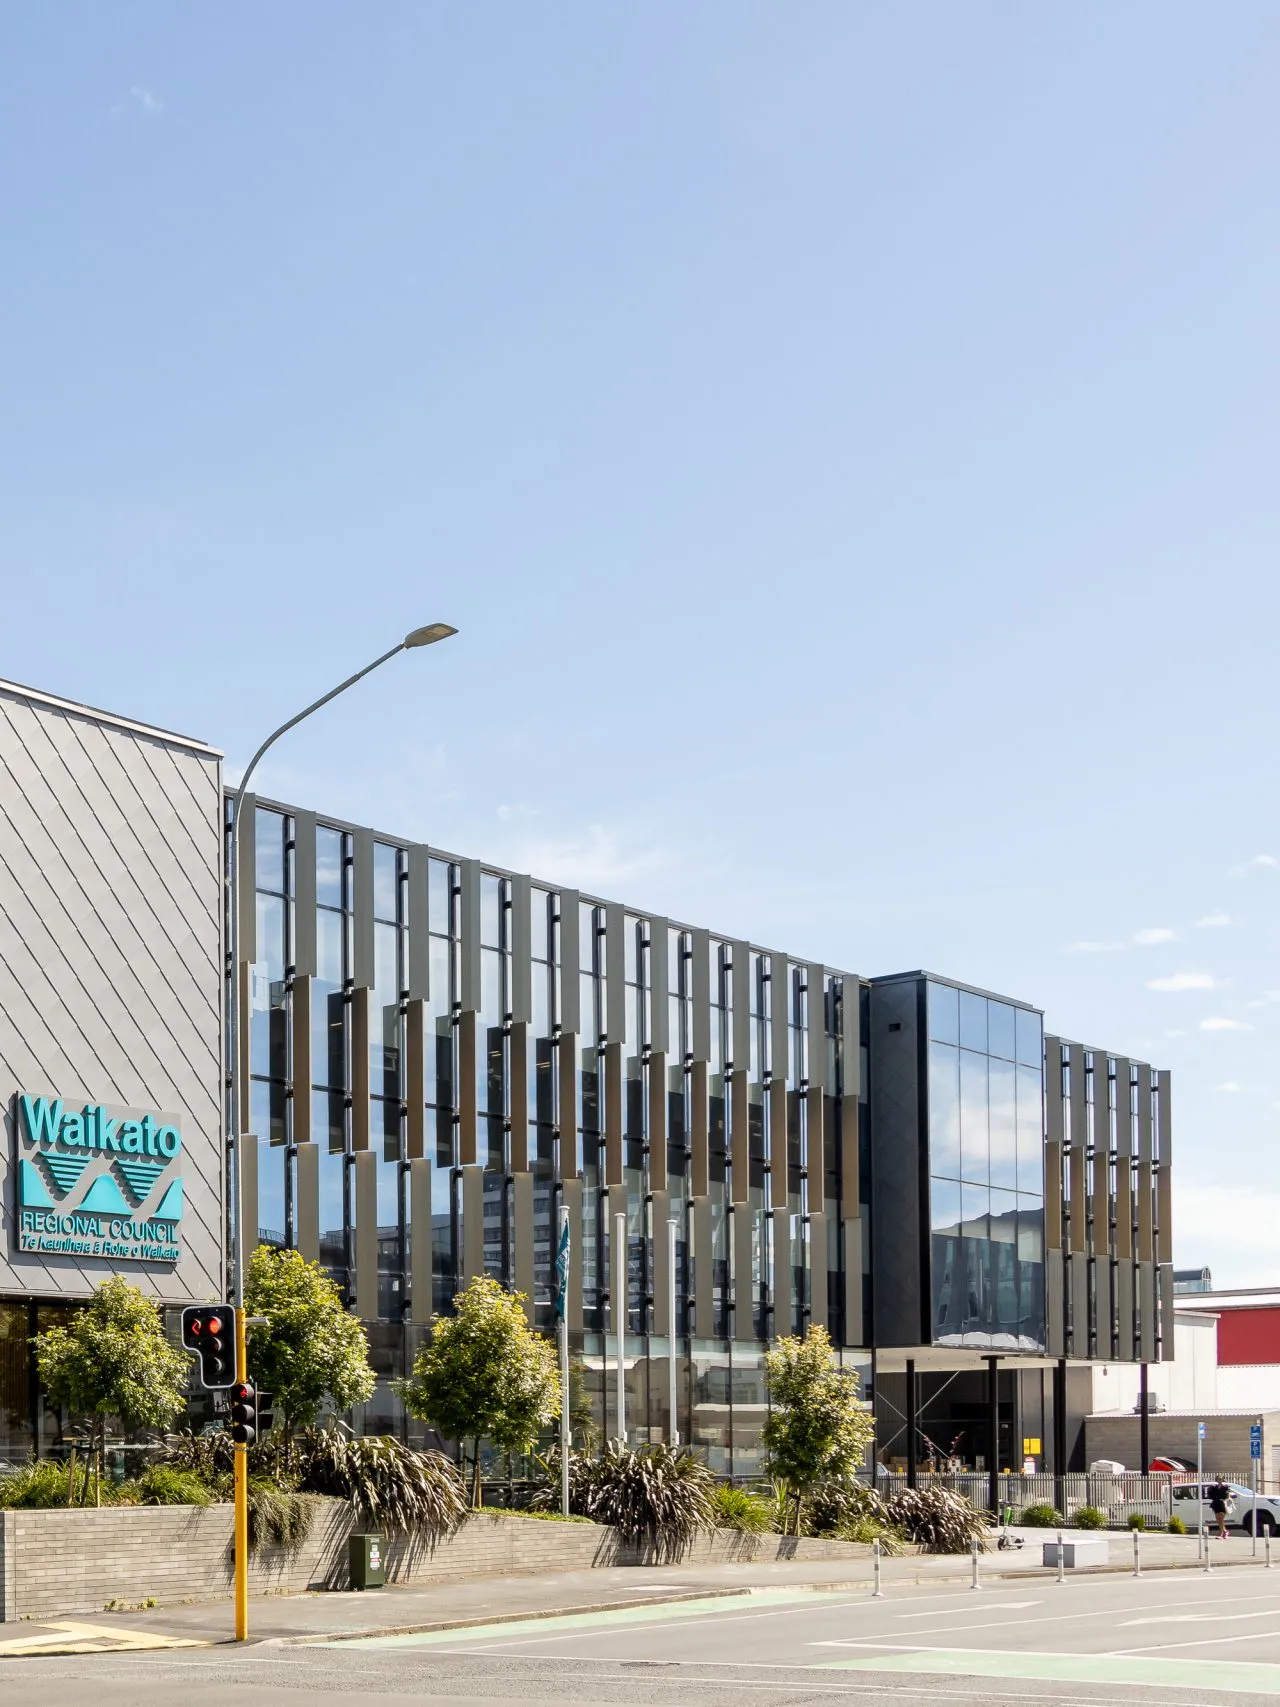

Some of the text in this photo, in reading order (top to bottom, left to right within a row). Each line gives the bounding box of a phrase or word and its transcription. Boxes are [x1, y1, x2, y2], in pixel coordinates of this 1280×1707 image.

[20, 1095, 181, 1158] Waikato
[21, 1211, 178, 1244] REGIONAL COUNCIL
[22, 1233, 37, 1249] Te
[38, 1235, 91, 1254] Kaunihera
[103, 1240, 129, 1257] Rohe
[131, 1246, 139, 1257] o
[141, 1243, 179, 1260] Waikato
